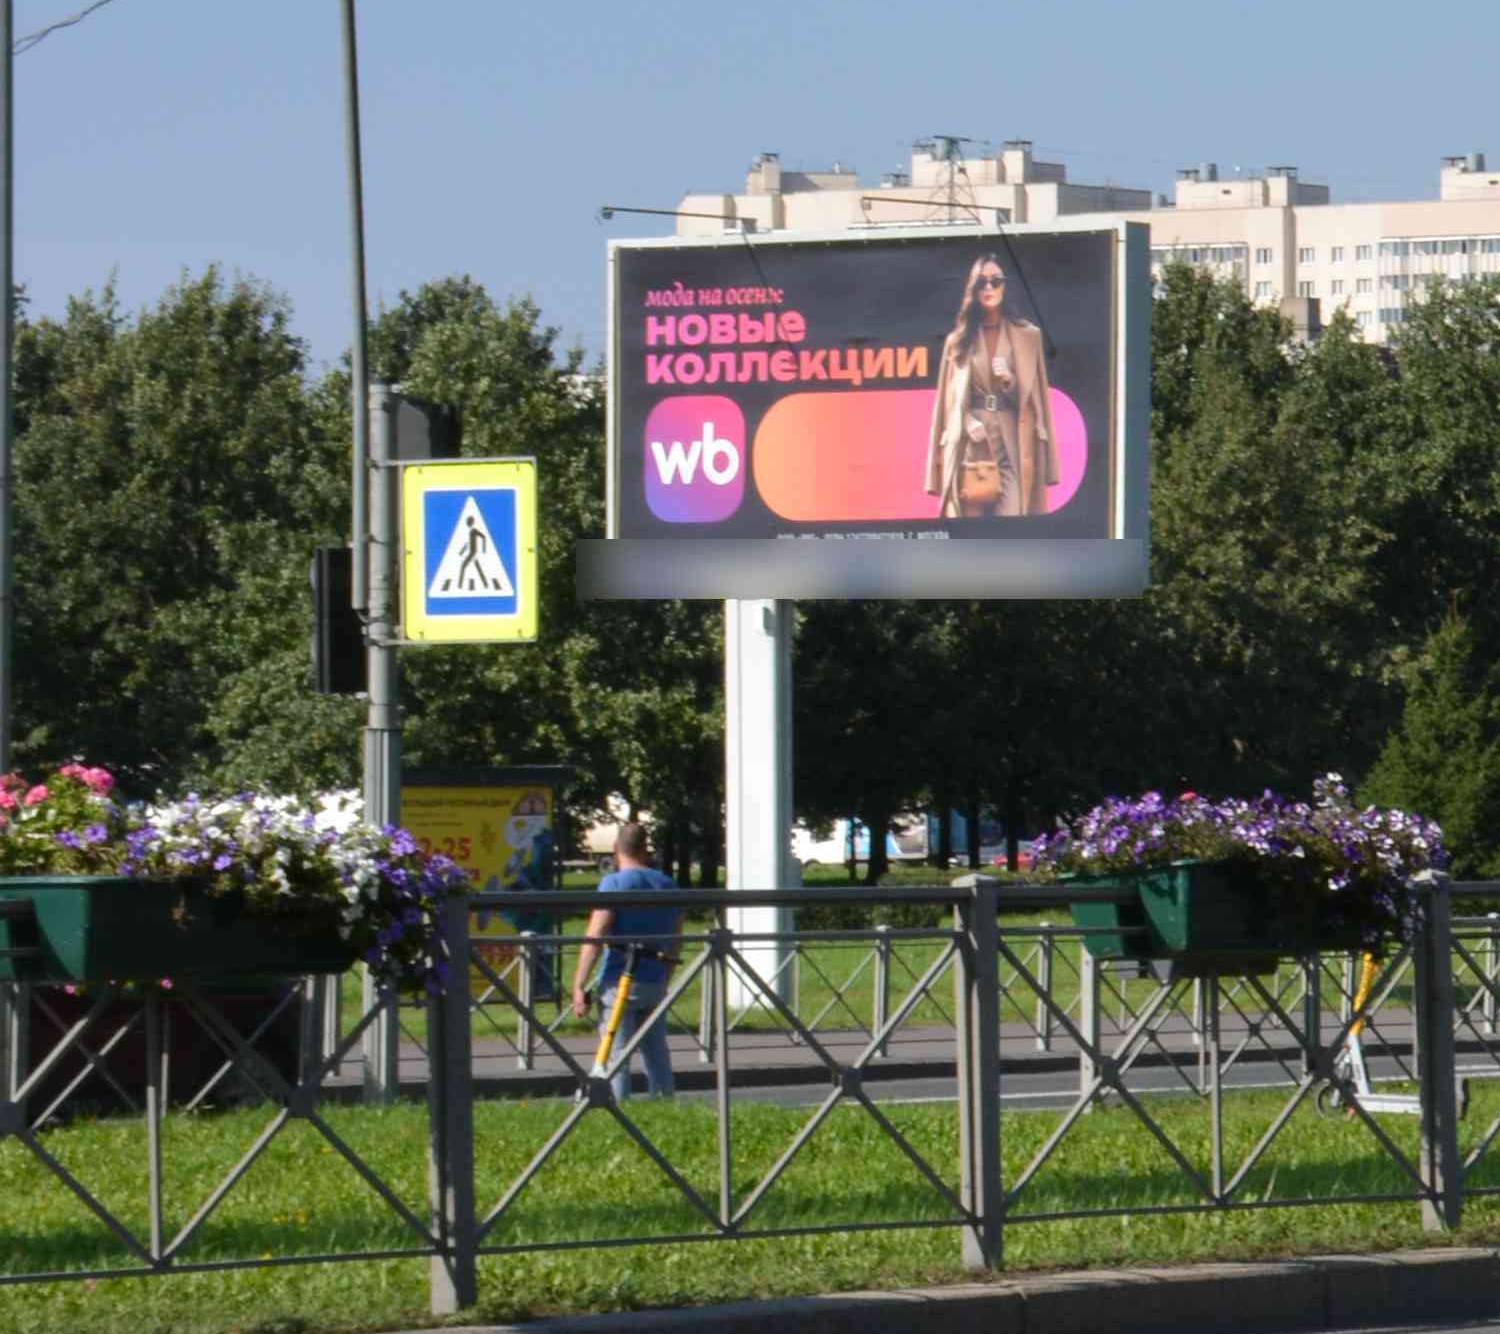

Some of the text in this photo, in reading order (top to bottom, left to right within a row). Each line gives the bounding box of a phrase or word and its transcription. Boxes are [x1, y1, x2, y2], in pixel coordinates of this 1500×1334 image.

[644, 281, 695, 308] мода
[698, 287, 722, 307] на
[651, 421, 740, 486] wb
